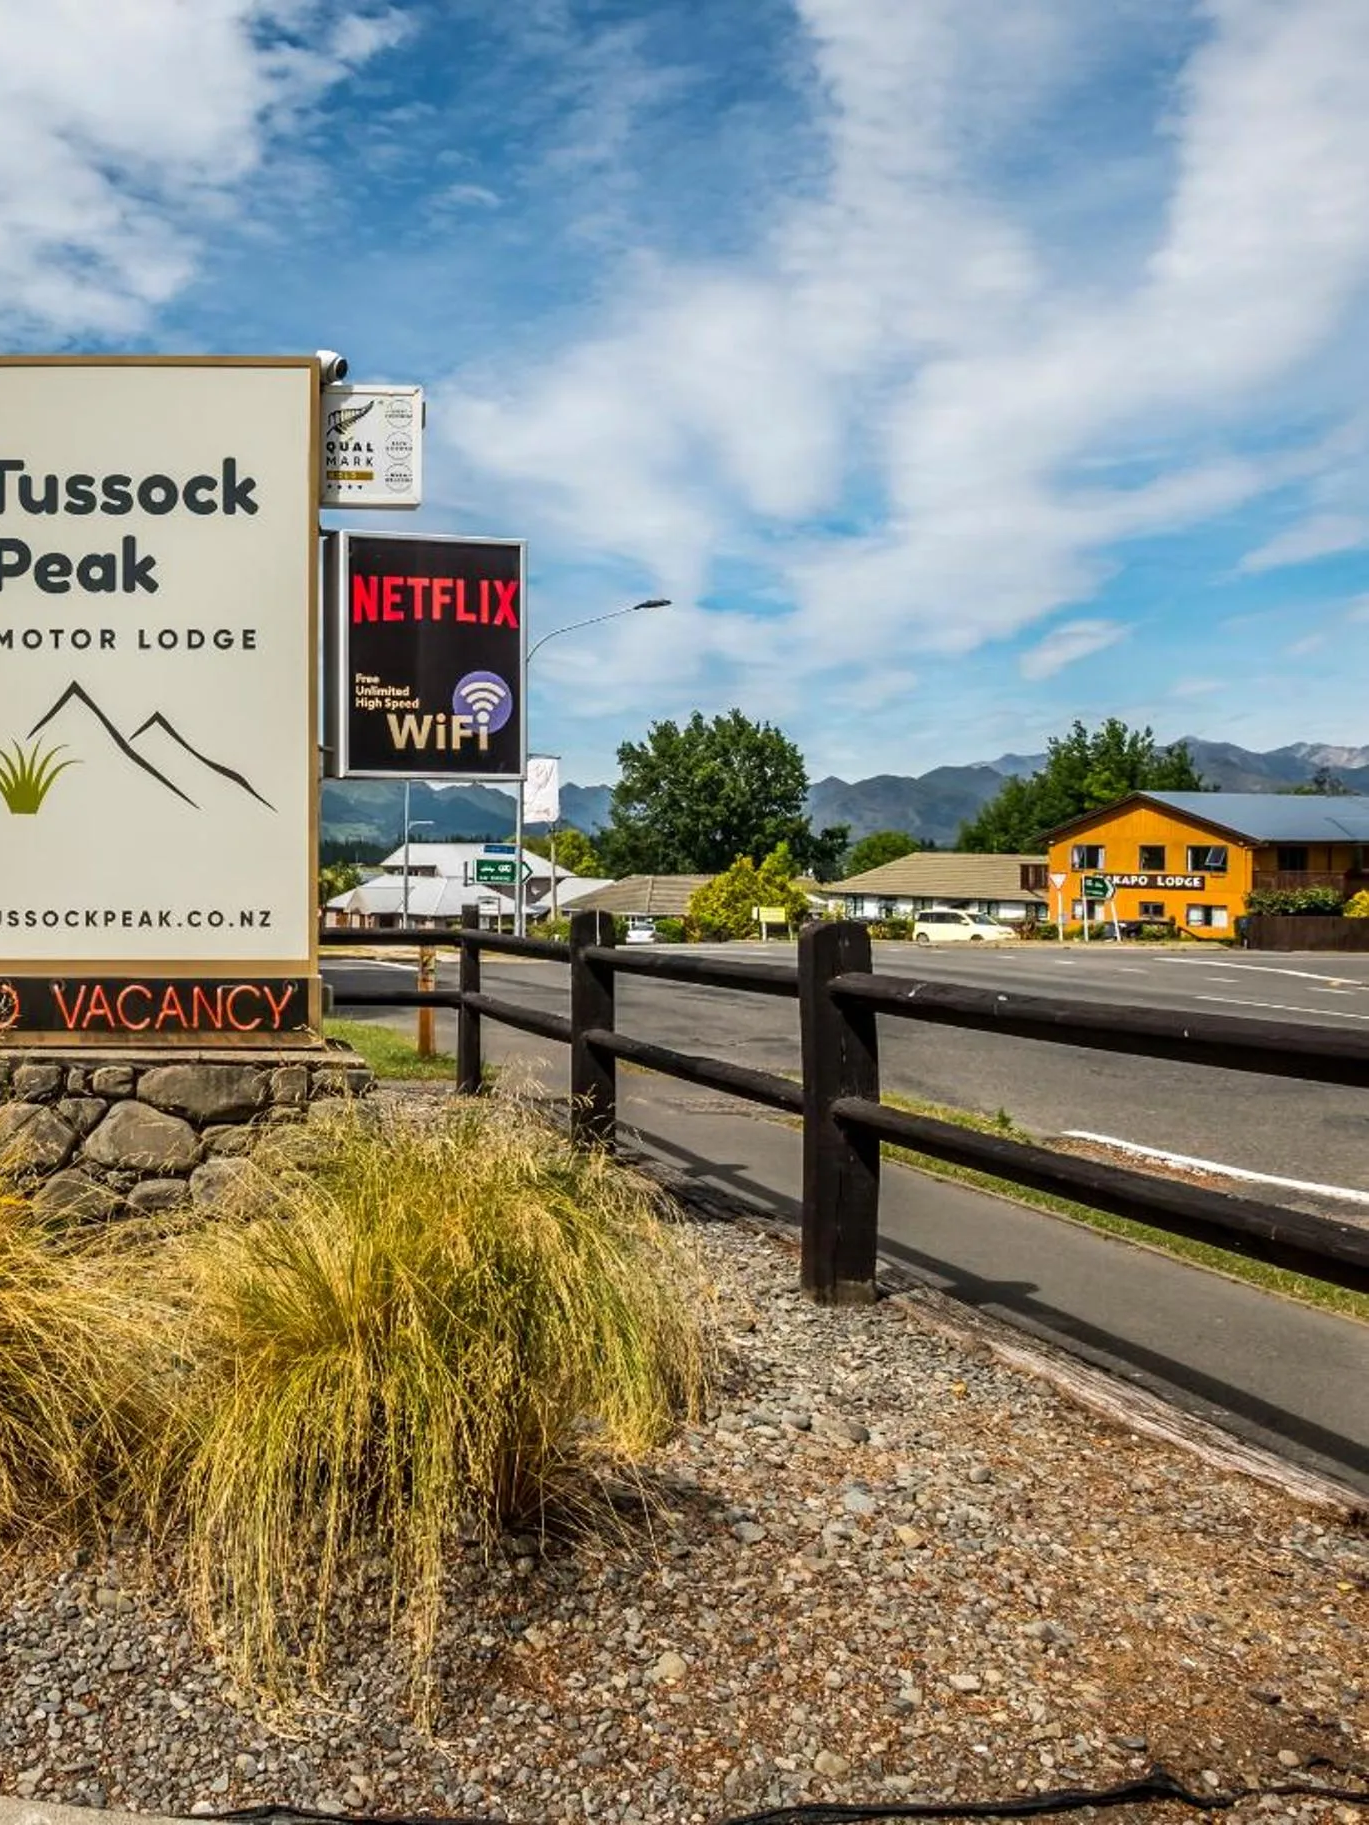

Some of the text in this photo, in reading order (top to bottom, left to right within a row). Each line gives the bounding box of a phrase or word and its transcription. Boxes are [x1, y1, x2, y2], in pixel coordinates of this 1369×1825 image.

[326, 441, 373, 453] QUAL
[326, 456, 373, 467] MARK
[354, 573, 519, 629] NETFLIX
[138, 629, 257, 650] LODGE
[355, 673, 380, 684] Free
[355, 685, 410, 697] Unlimited
[355, 698, 420, 711] High Speed
[387, 712, 488, 750] WiFi
[1094, 875, 1201, 887] AKAPO LODGE
[53, 984, 294, 1030] VACANCY
